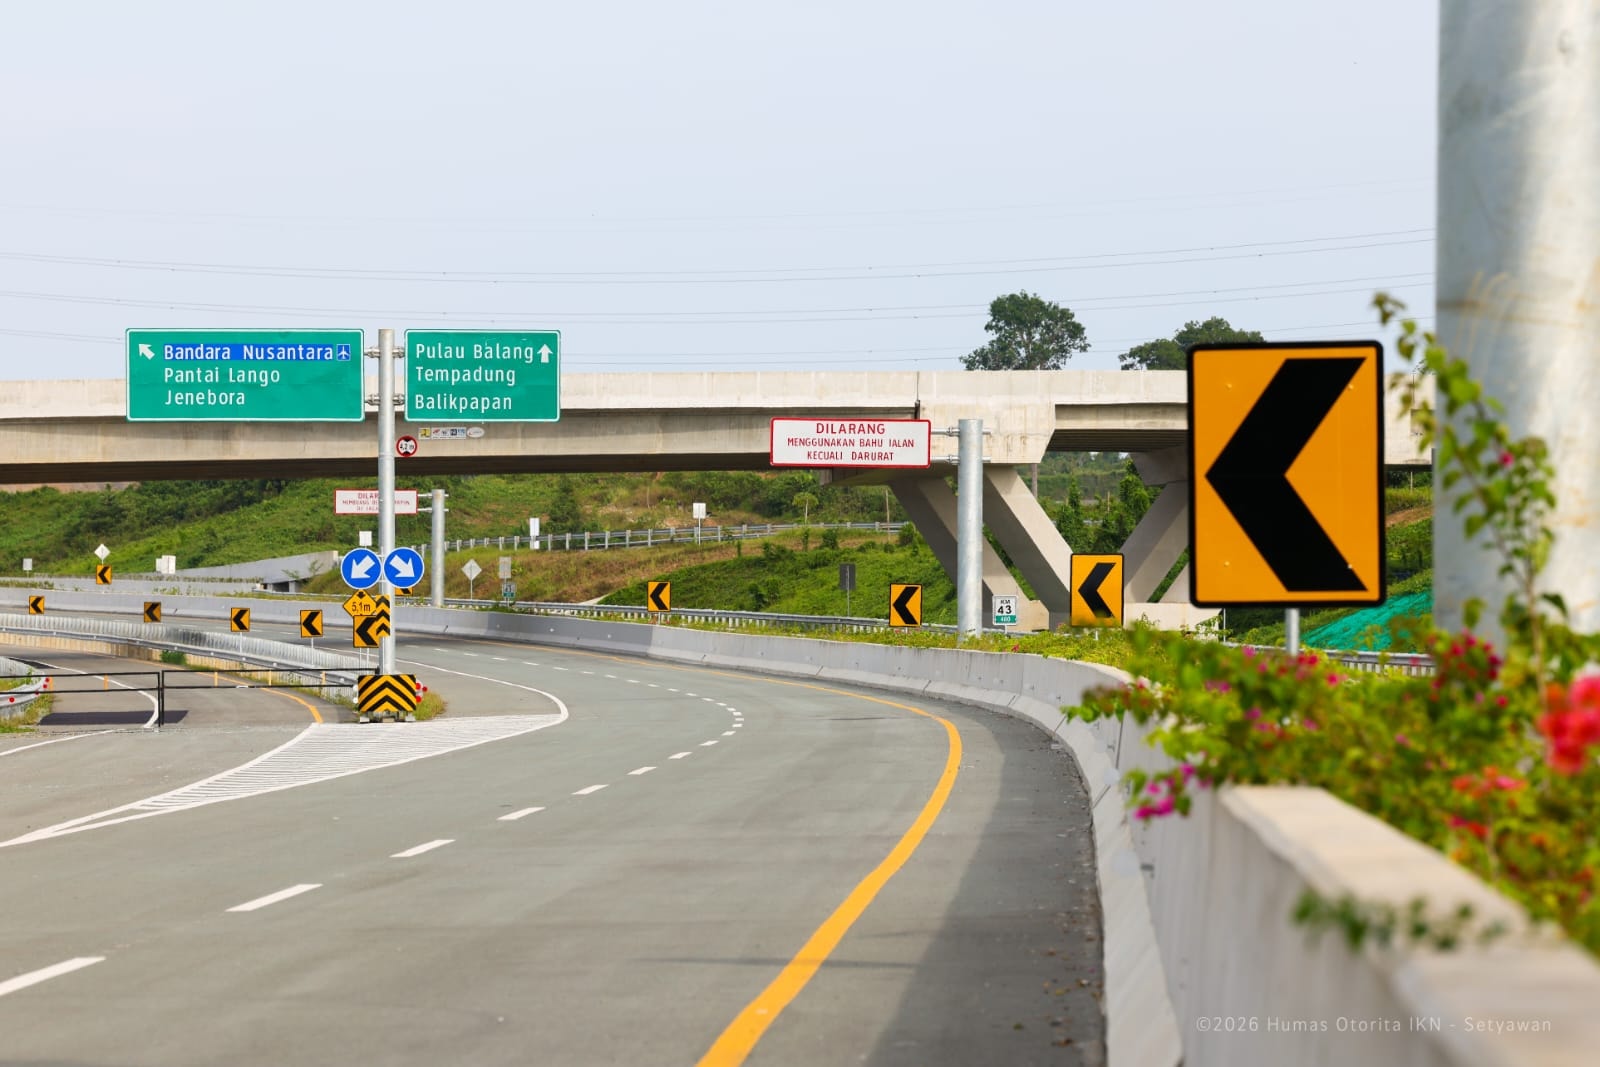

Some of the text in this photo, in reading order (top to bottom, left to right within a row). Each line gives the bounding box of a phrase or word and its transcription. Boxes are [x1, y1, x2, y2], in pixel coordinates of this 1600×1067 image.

[164, 344, 333, 360] Bandara Nusantara
[415, 343, 534, 363] Pulau Balang
[164, 367, 281, 387] Pantai Lango
[415, 366, 516, 387] Tempadung
[164, 389, 245, 406] Jenebora
[415, 393, 513, 414] Balikpapan
[816, 422, 886, 434] DILARANG
[787, 437, 855, 448] MENGGUNAKAN
[859, 438, 884, 448] BAHU
[807, 450, 895, 461] KECUALI DARURAT
[997, 605, 1012, 614] 43
